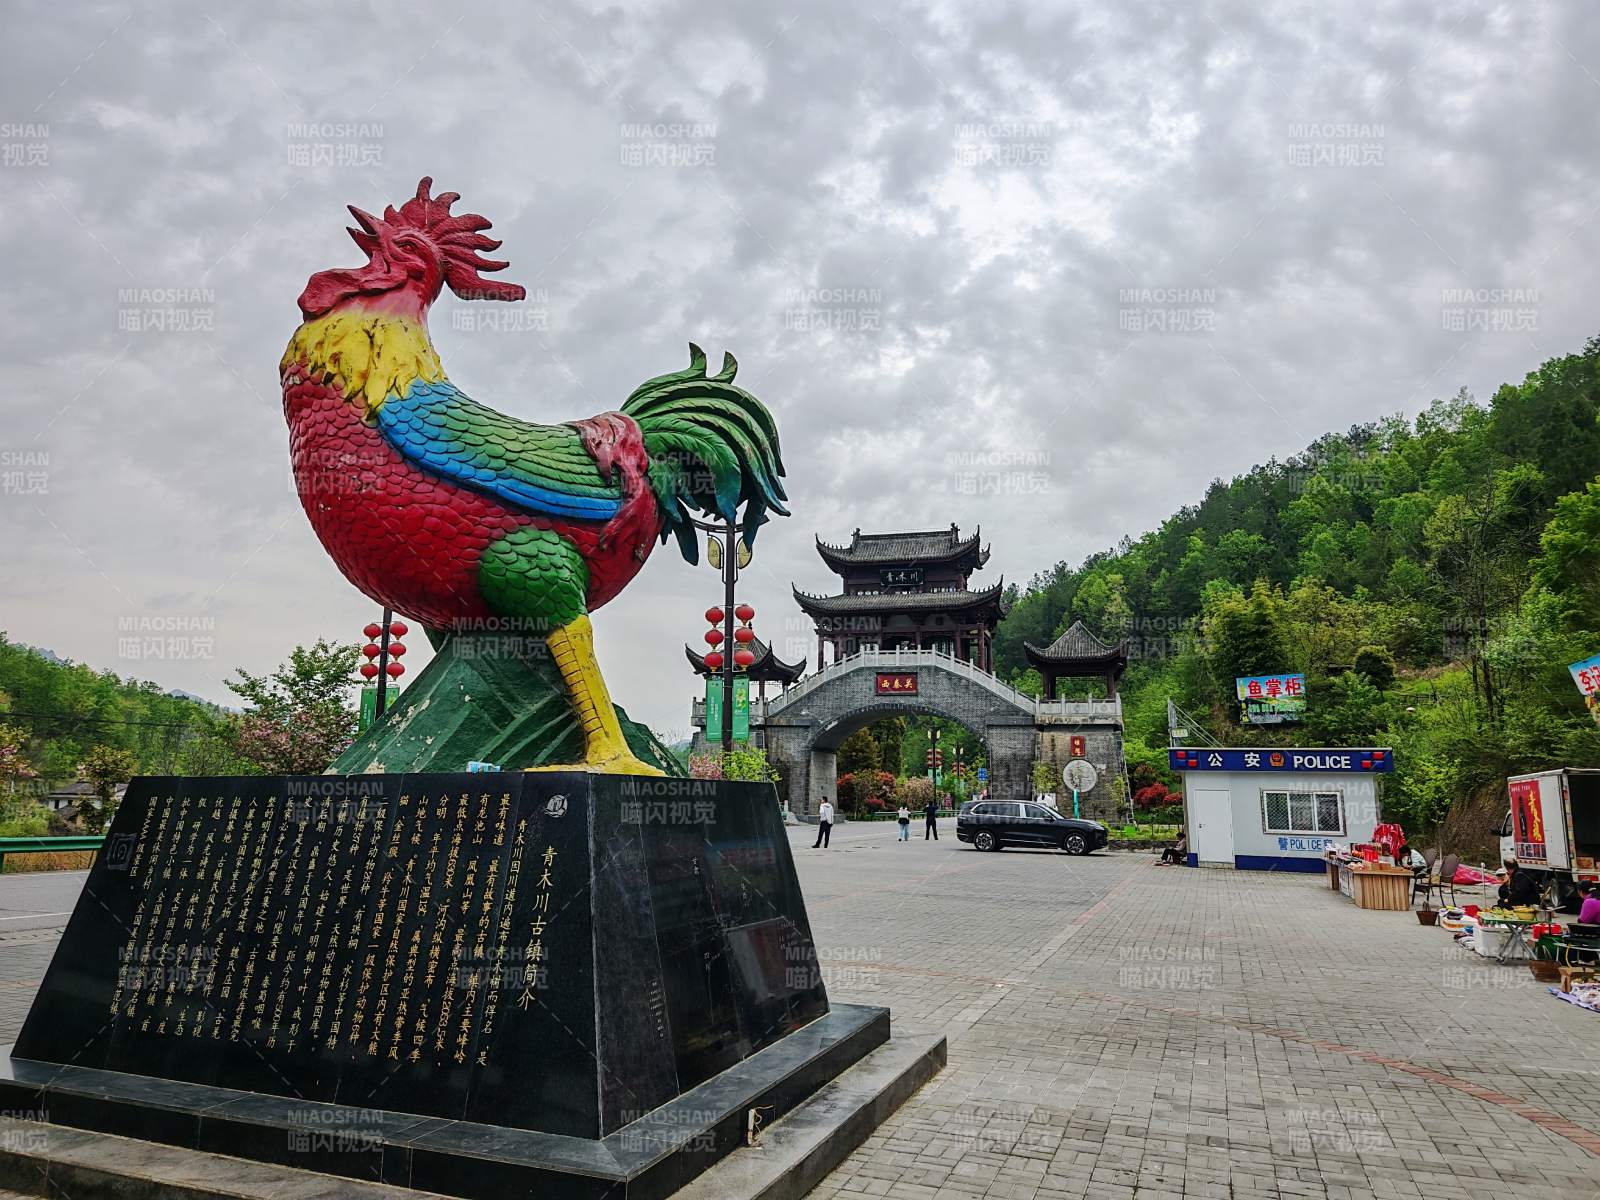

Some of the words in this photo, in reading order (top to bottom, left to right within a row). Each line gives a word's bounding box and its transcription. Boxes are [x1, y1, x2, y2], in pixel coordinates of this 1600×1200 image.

[1247, 677, 1302, 699] 鱼掌柜
[1293, 755, 1351, 769] POLICE
[516, 845, 559, 1012] 青木川古镇简介
